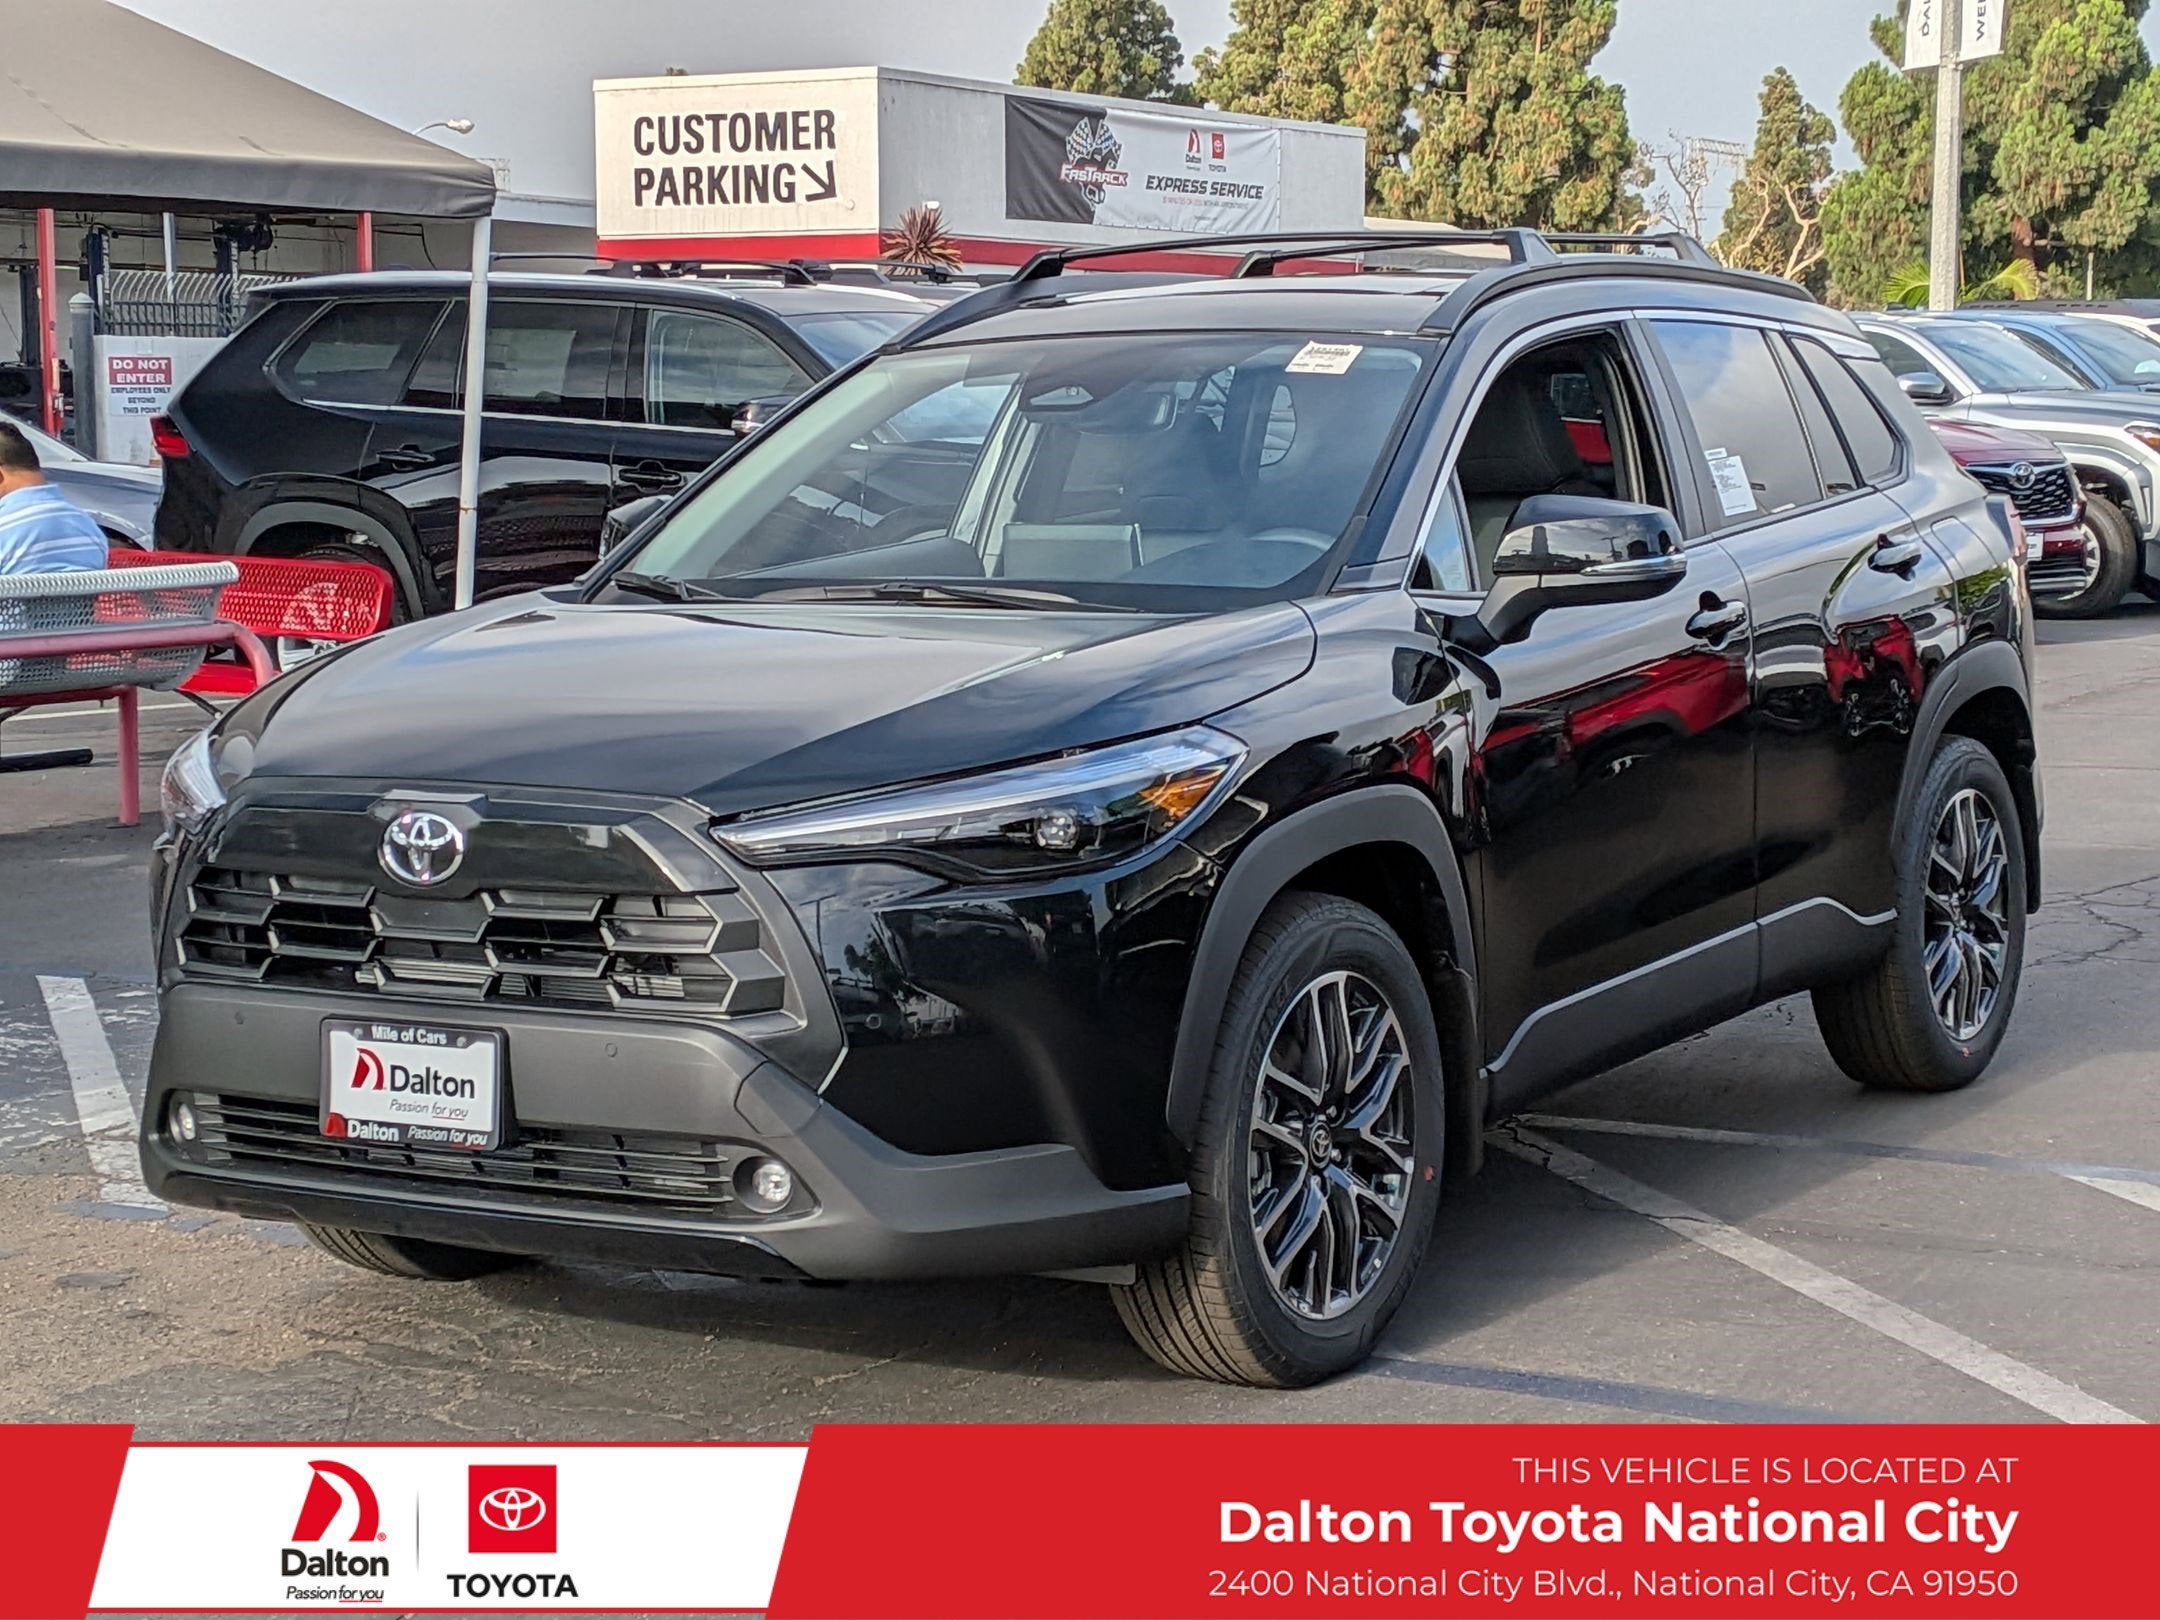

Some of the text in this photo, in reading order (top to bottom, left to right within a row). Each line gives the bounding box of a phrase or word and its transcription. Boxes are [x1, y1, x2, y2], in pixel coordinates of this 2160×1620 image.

[634, 109, 836, 156] CUSTOMER
[634, 163, 796, 207] PARKING
[1146, 175, 1264, 199] EXPRESS SERVICE
[112, 359, 168, 370] DO NOT
[116, 373, 166, 384] ENTER
[371, 1025, 447, 1045] Mile of Cars
[390, 1064, 475, 1099] Dalton
[389, 1099, 469, 1119] Passion for you
[347, 1119, 488, 1146] Dalton Passion for you
